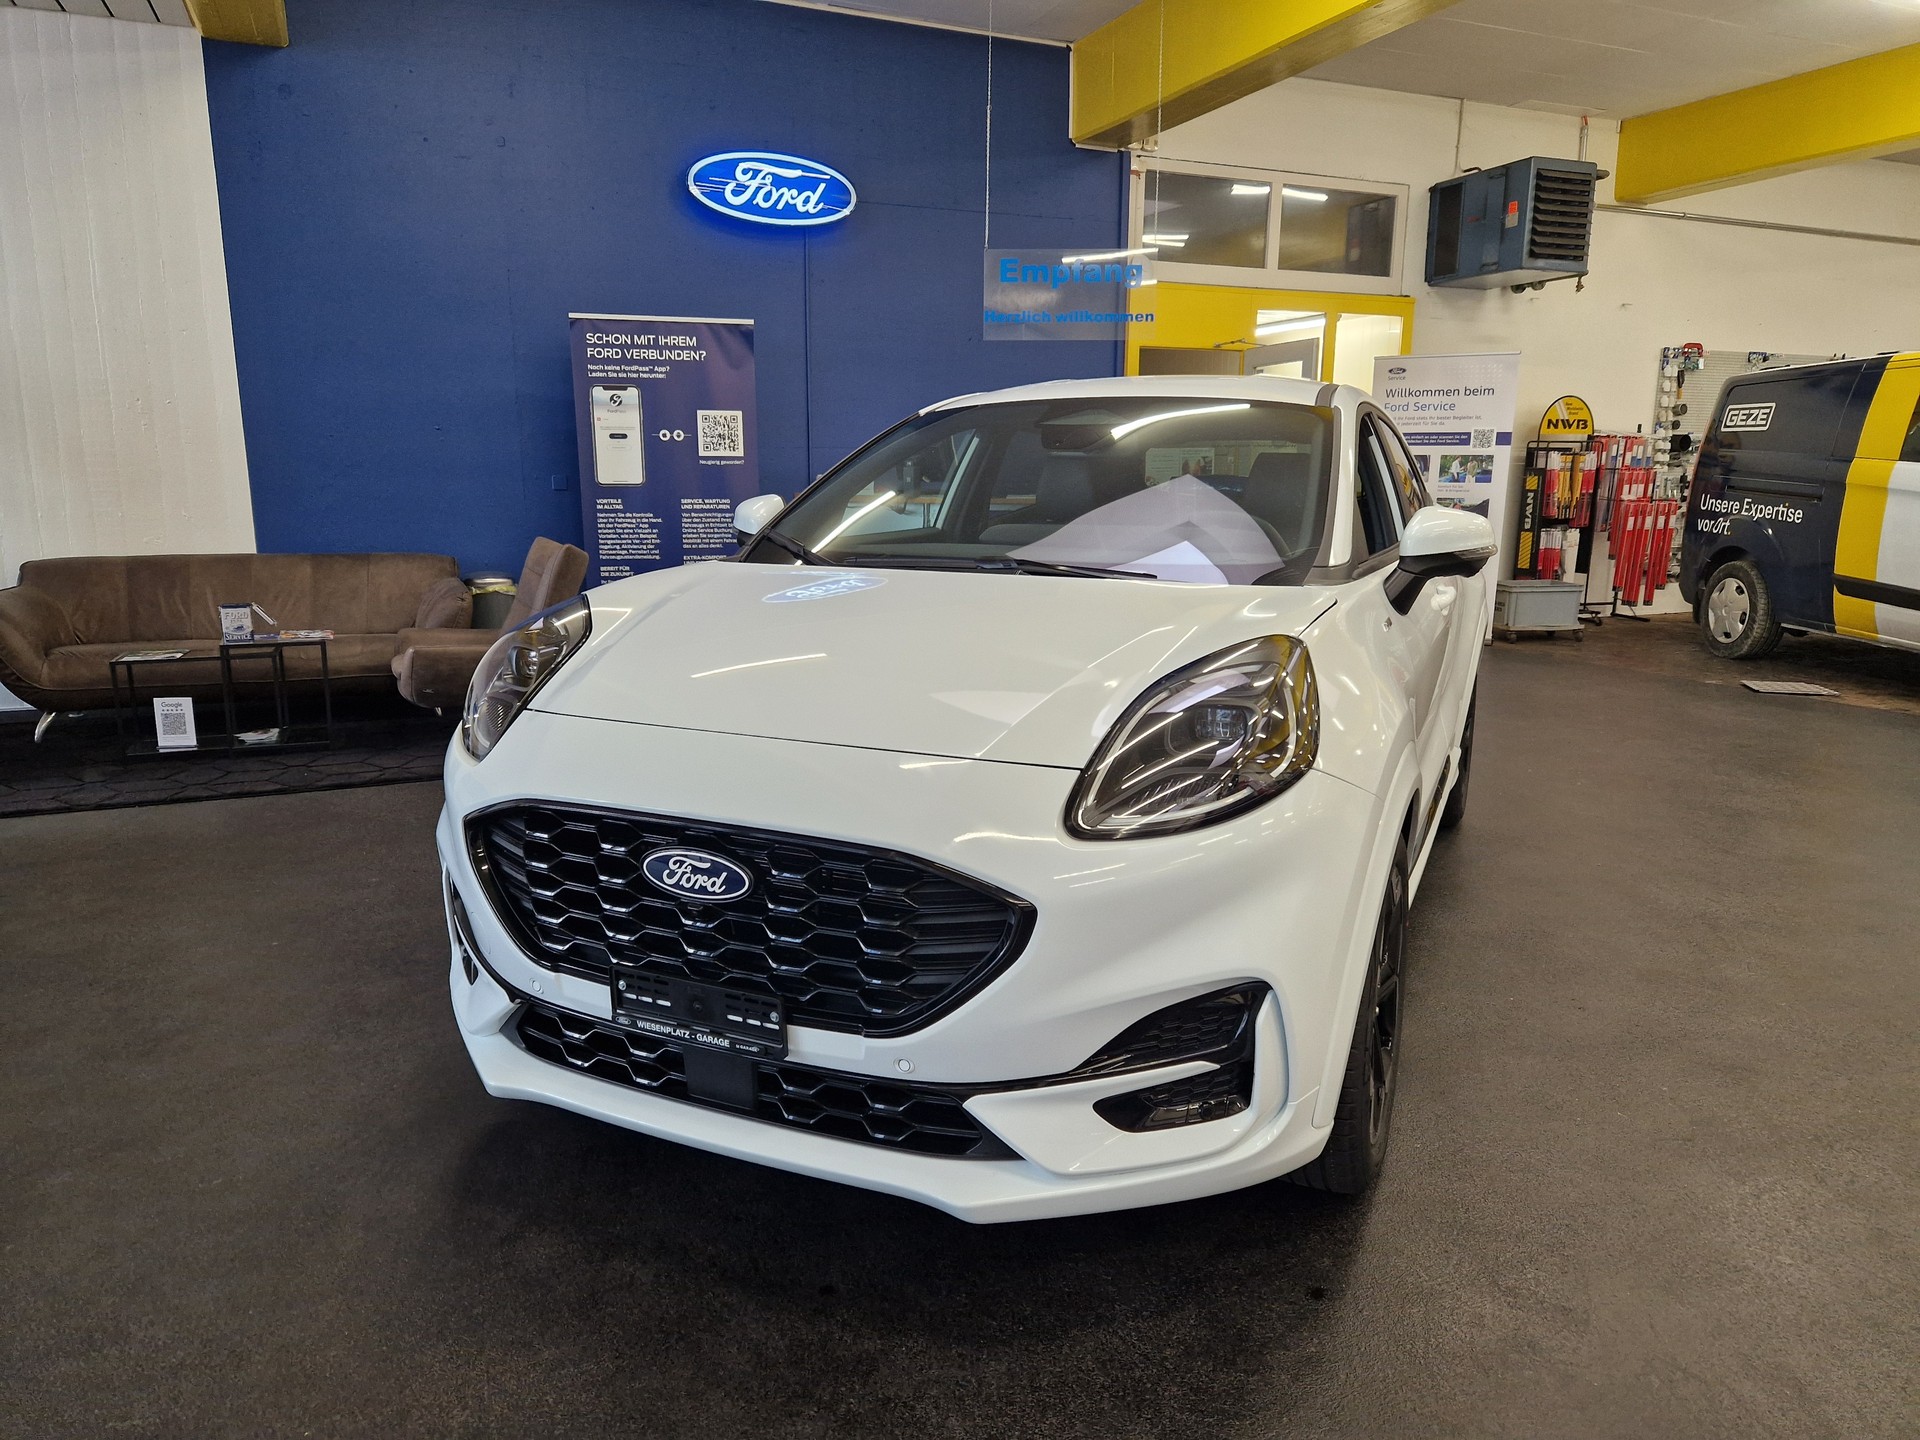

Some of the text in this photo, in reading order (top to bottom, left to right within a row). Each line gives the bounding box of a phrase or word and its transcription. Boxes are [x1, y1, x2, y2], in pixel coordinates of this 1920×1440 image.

[724, 161, 827, 214] Ford
[1000, 257, 1142, 289] Empfang
[984, 310, 1154, 324] Herzlich willkommen
[586, 332, 697, 347] SCHON MIT IHREM
[586, 348, 707, 361] FORD VERBUNDEN?
[1386, 386, 1495, 398] Willkommen beim
[1384, 401, 1456, 412] Ford Service
[1546, 419, 1589, 430] NWB
[1726, 408, 1771, 426] GEZE
[1524, 492, 1534, 529] NWB
[1700, 494, 1803, 523] Unsere Expertise
[225, 612, 249, 620] FORD
[662, 856, 728, 893] Ford
[636, 1020, 690, 1039] WIESENPLATZ
[696, 1033, 730, 1047] GARAGE
